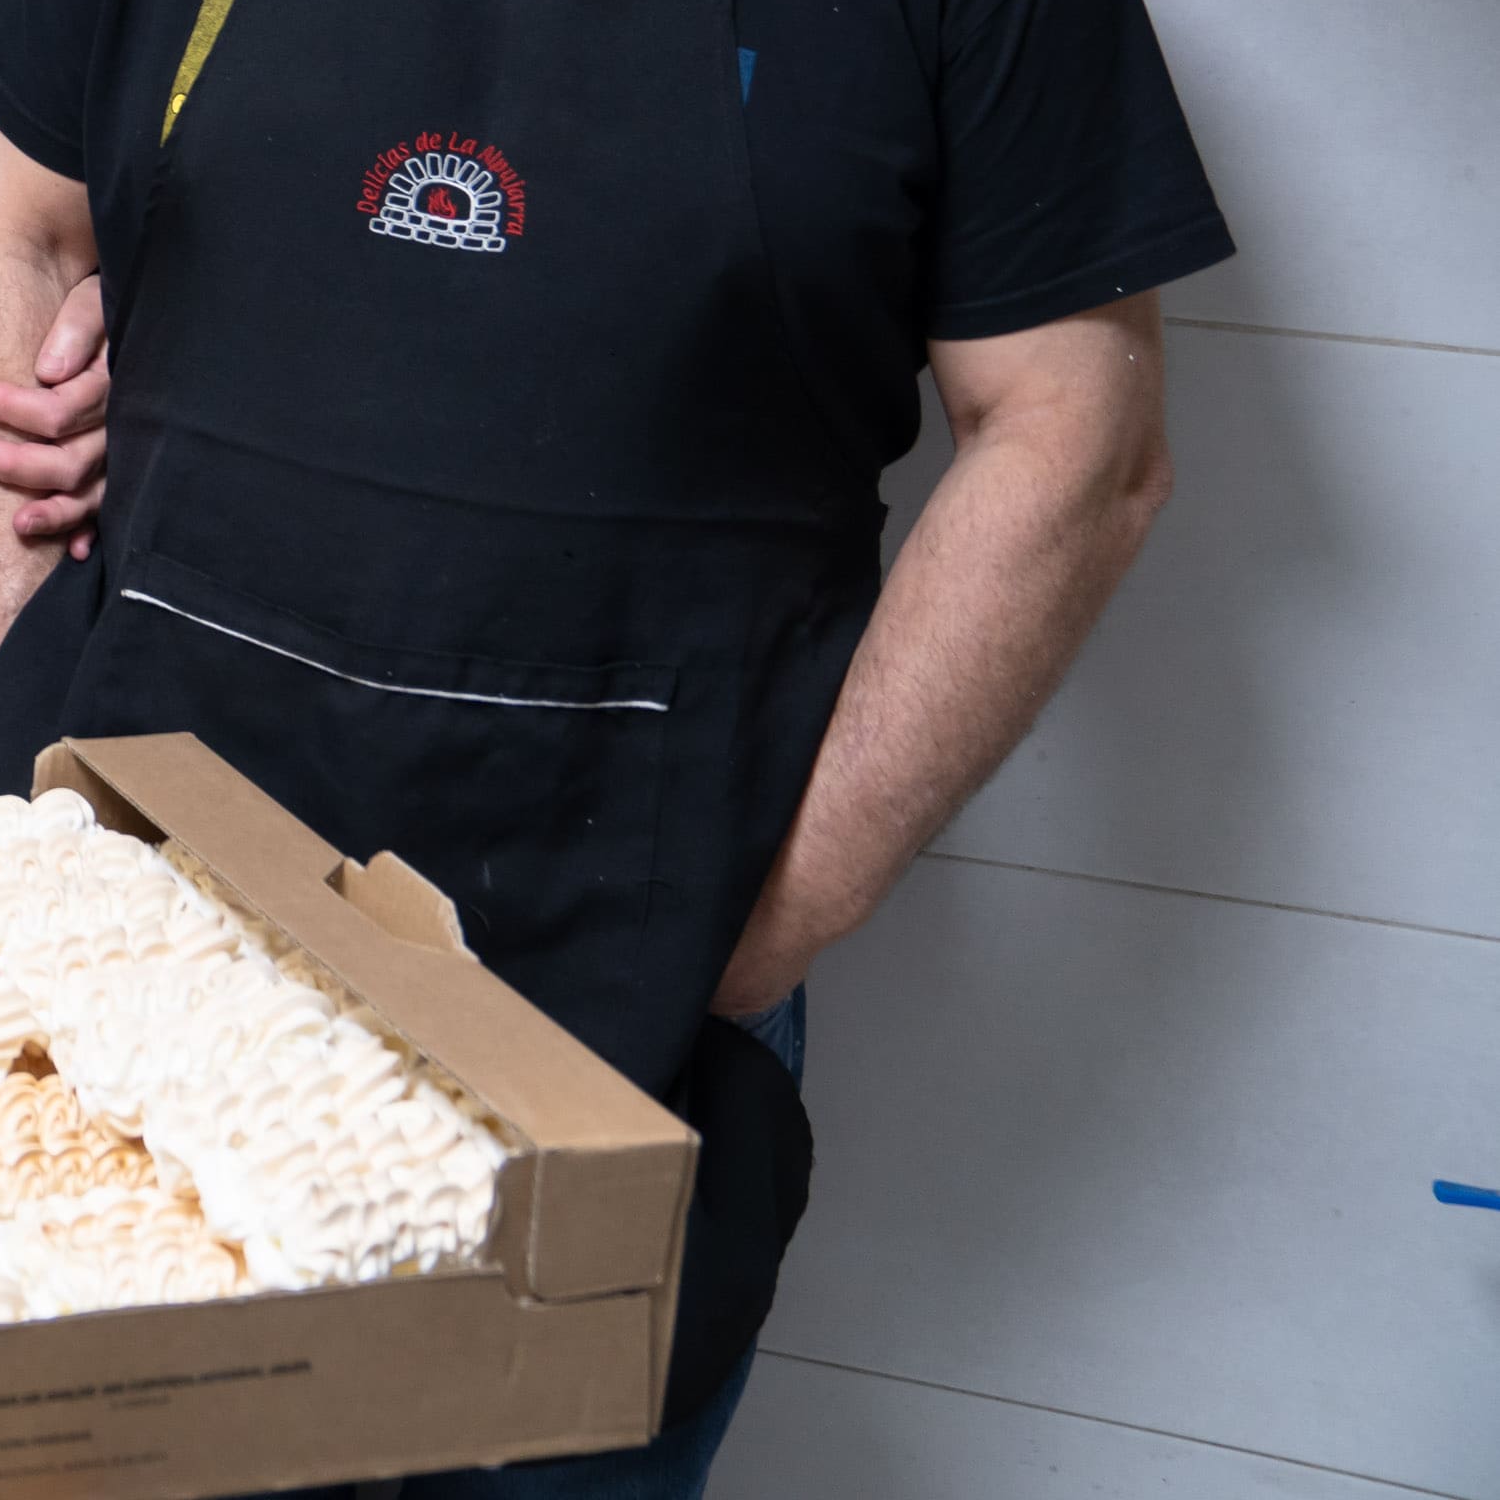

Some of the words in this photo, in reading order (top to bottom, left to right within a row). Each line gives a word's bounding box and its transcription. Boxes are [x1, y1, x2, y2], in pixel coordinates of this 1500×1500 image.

[356, 142, 410, 215] Delicias
[415, 131, 443, 151] de
[448, 131, 478, 153] La
[477, 145, 526, 236] Alpujarra
